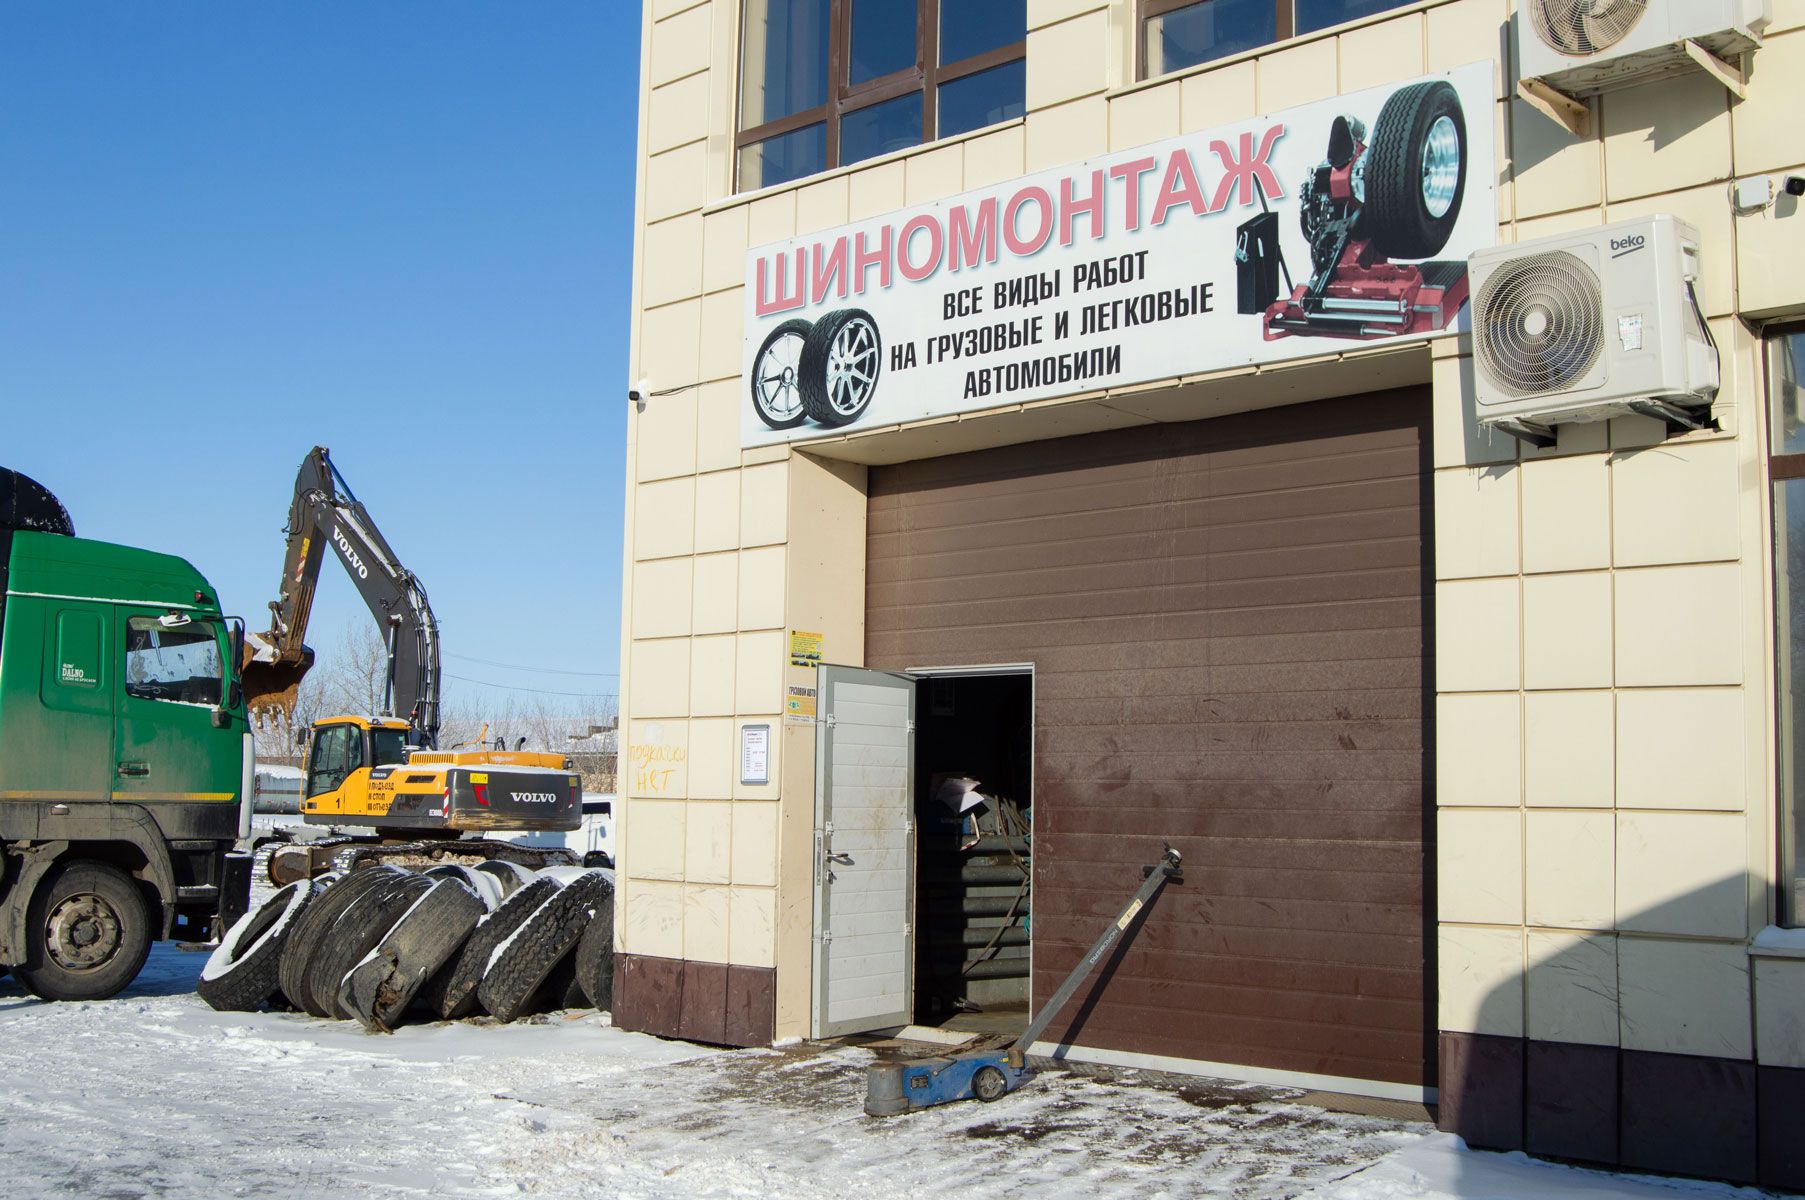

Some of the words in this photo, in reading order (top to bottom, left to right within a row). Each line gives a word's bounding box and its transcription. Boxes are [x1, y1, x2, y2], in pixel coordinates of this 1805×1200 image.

[755, 123, 1285, 318] ШИНОМОНТАЖ
[1610, 235, 1645, 250] beko
[943, 286, 983, 321] ВСЕ
[994, 269, 1061, 311] ВИДЫ
[1073, 250, 1149, 294] РАБОТ
[890, 341, 917, 372] НА
[927, 315, 1043, 365] ГРУЗОВЫЕ
[1054, 310, 1069, 341] И
[1080, 282, 1214, 336] ЛЕГКОВЫЕ
[963, 344, 1121, 400] АВТОМОБИЛИ
[333, 524, 368, 579] VOLVO
[336, 798, 341, 809] 1
[510, 792, 557, 803] VOLVO
